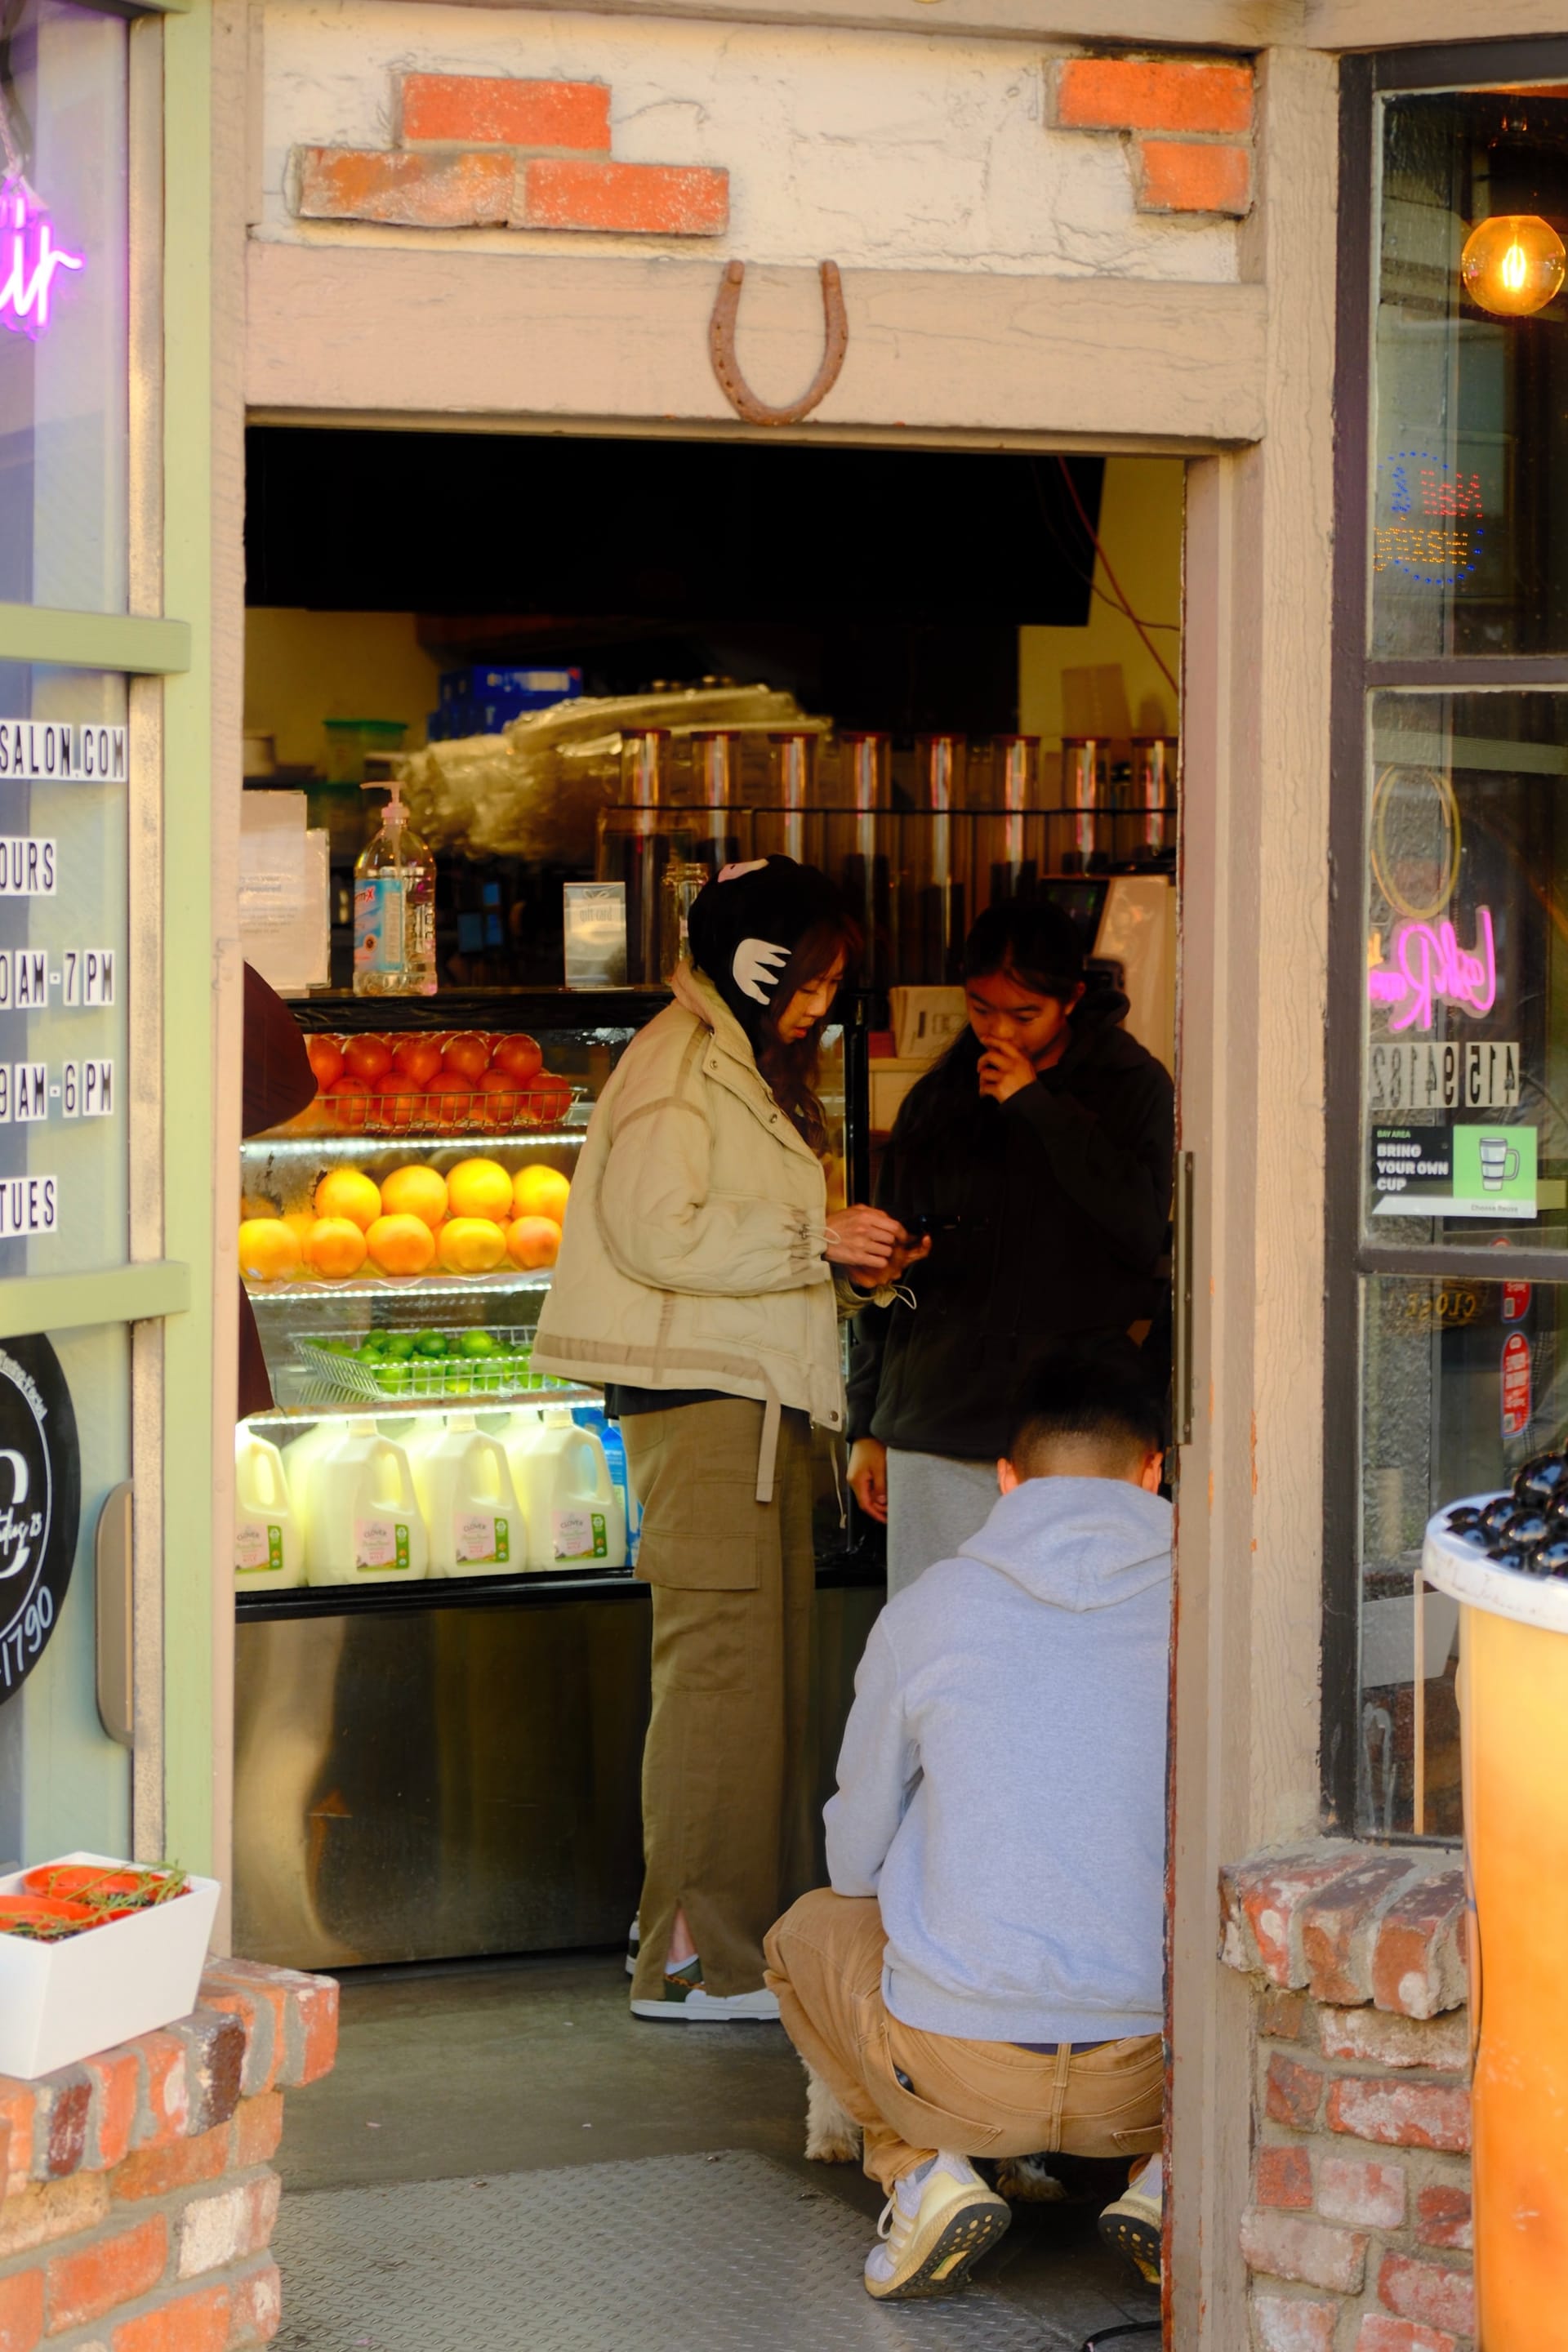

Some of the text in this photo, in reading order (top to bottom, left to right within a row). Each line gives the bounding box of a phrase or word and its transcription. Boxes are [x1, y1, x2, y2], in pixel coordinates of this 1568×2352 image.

[0, 724, 124, 777] SALON.COM
[1392, 1130, 1411, 1138] AREA
[1377, 1143, 1422, 1158] BRING
[1377, 1160, 1449, 1175] YOUR OWN
[1377, 1177, 1407, 1192] CUP
[0, 1179, 54, 1234] TUES
[463, 1522, 487, 1533] CLOVER
[559, 1519, 584, 1530] CLOVER
